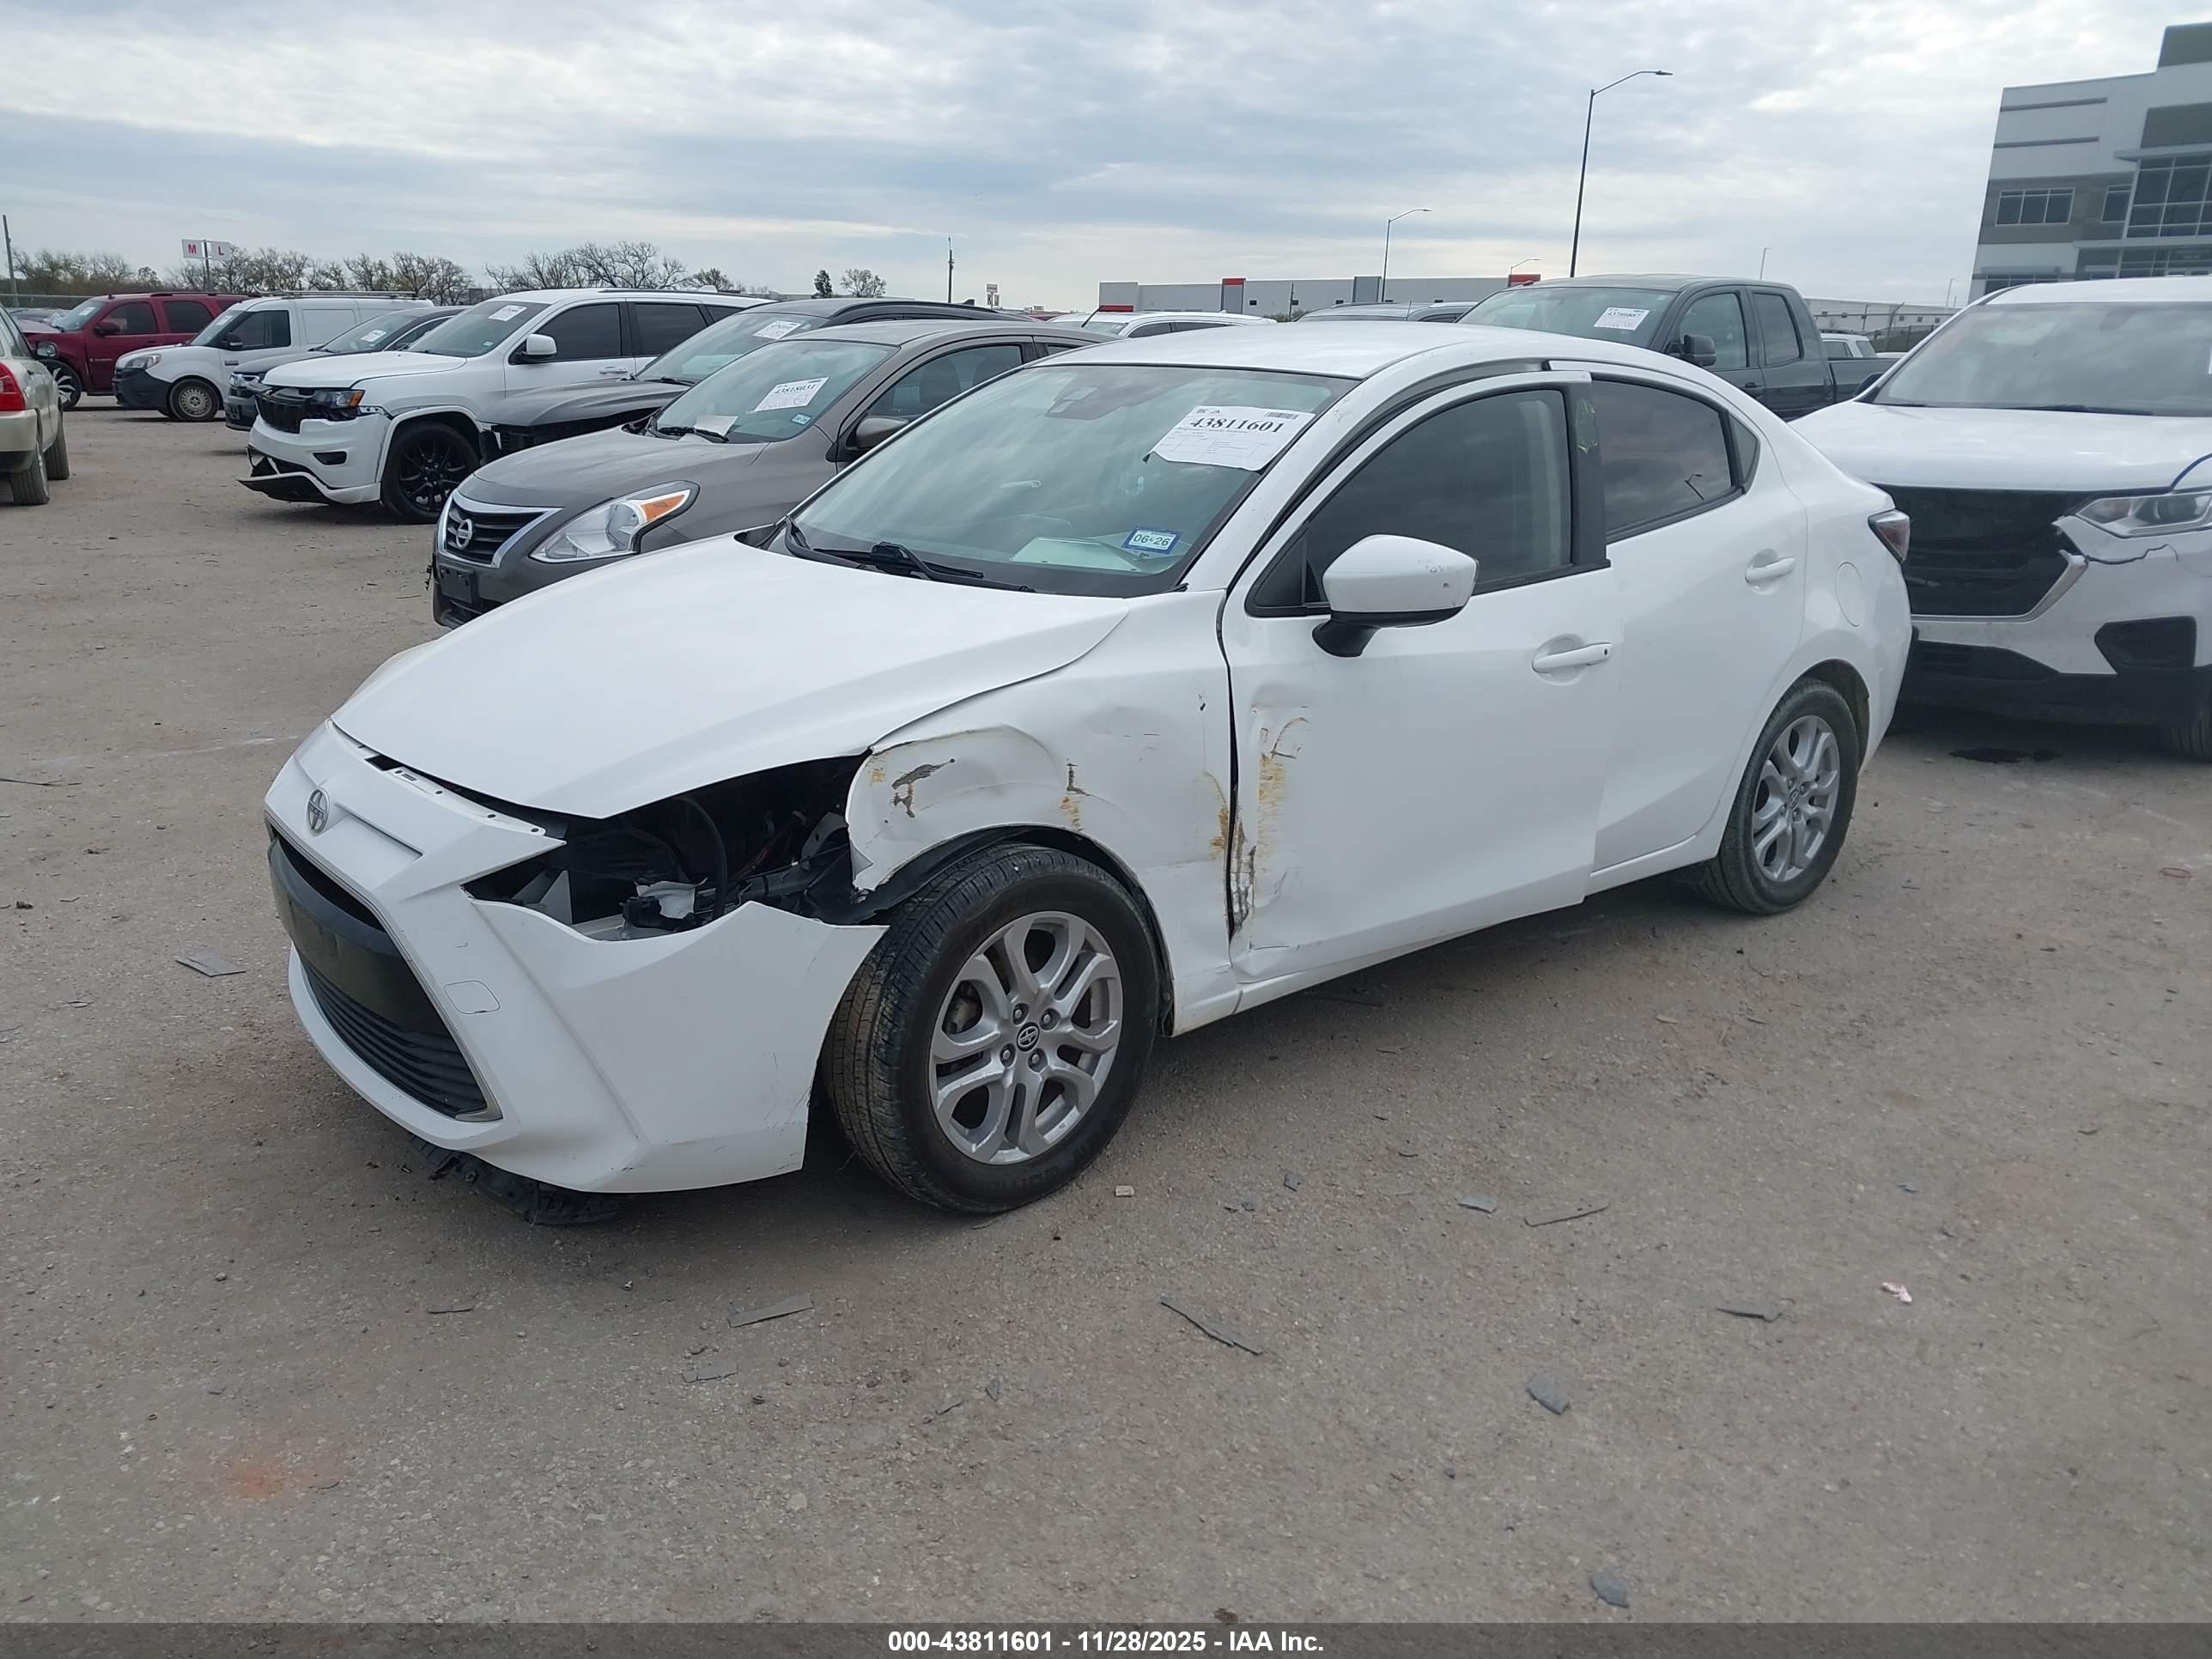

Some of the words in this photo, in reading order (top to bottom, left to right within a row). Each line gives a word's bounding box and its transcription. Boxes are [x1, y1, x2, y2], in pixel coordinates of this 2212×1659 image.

[187, 244, 197, 254] M
[217, 246, 225, 256] L
[1190, 417, 1285, 433] 43811601
[1133, 534, 1150, 544] 06
[1153, 537, 1170, 546] 26
